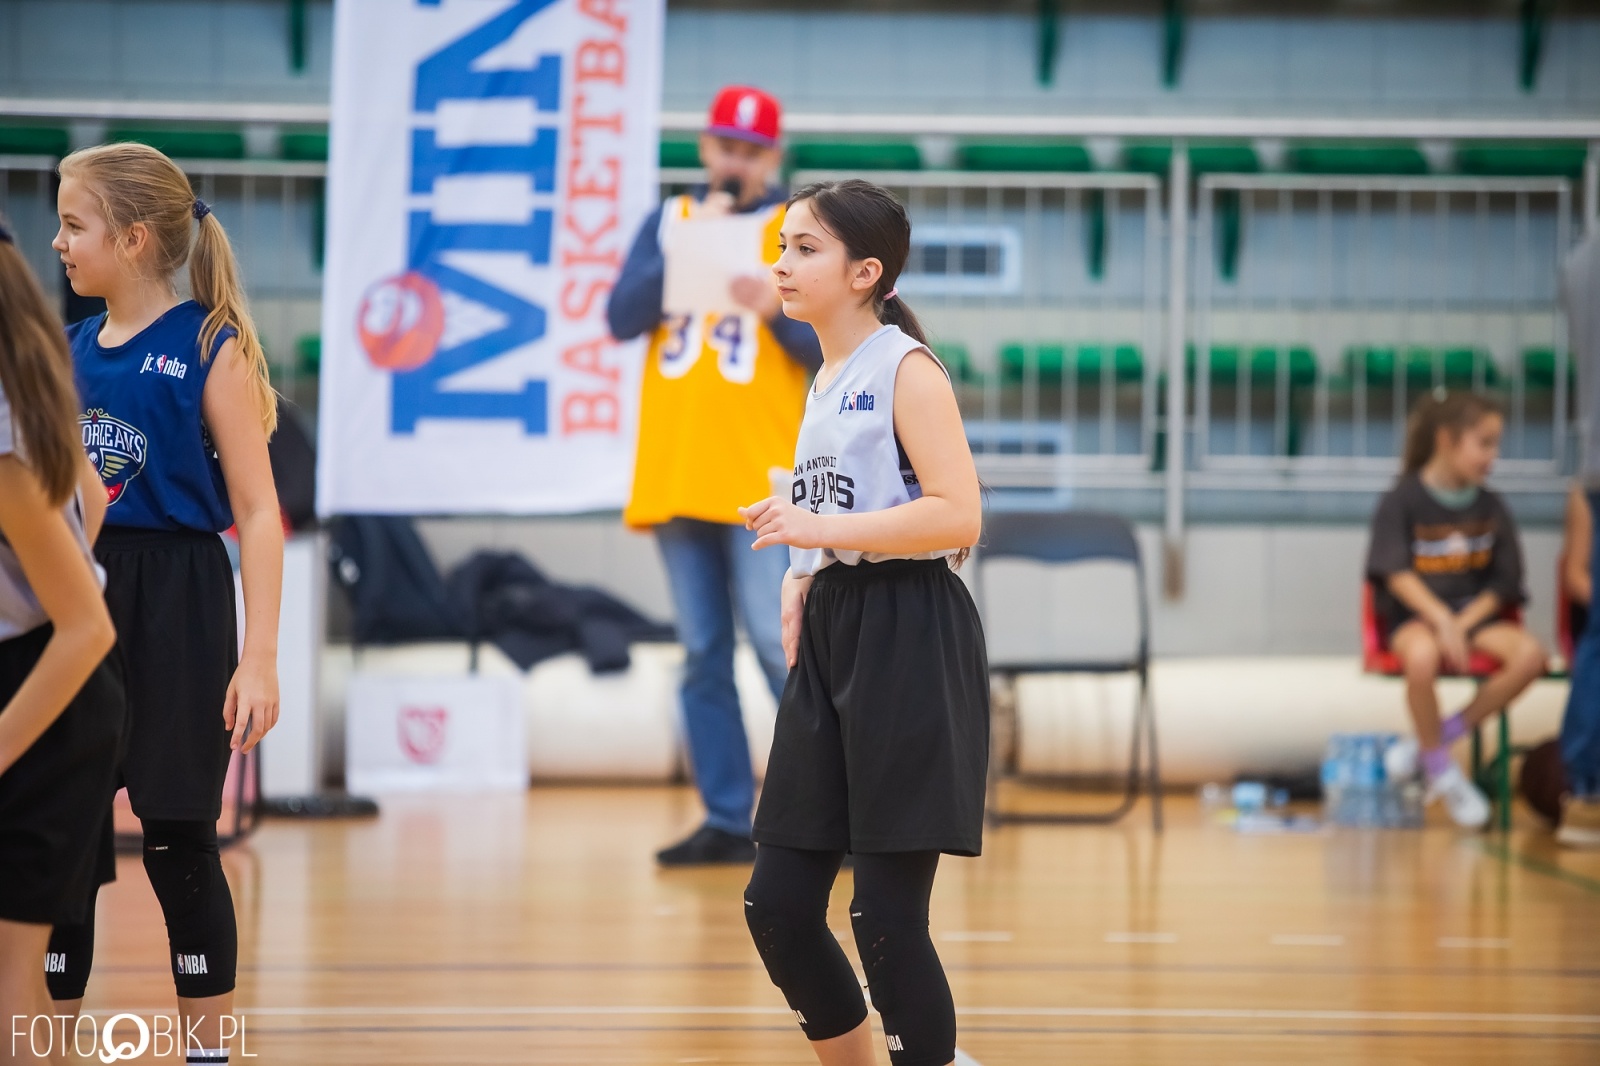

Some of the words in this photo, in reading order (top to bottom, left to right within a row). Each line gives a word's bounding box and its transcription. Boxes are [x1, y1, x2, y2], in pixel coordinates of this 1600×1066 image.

[140, 352, 155, 374] jr.
[162, 357, 188, 380] nba
[838, 391, 849, 415] jr.
[856, 390, 875, 411] nba
[82, 423, 144, 463] ORLEANS
[183, 954, 208, 975] NBA
